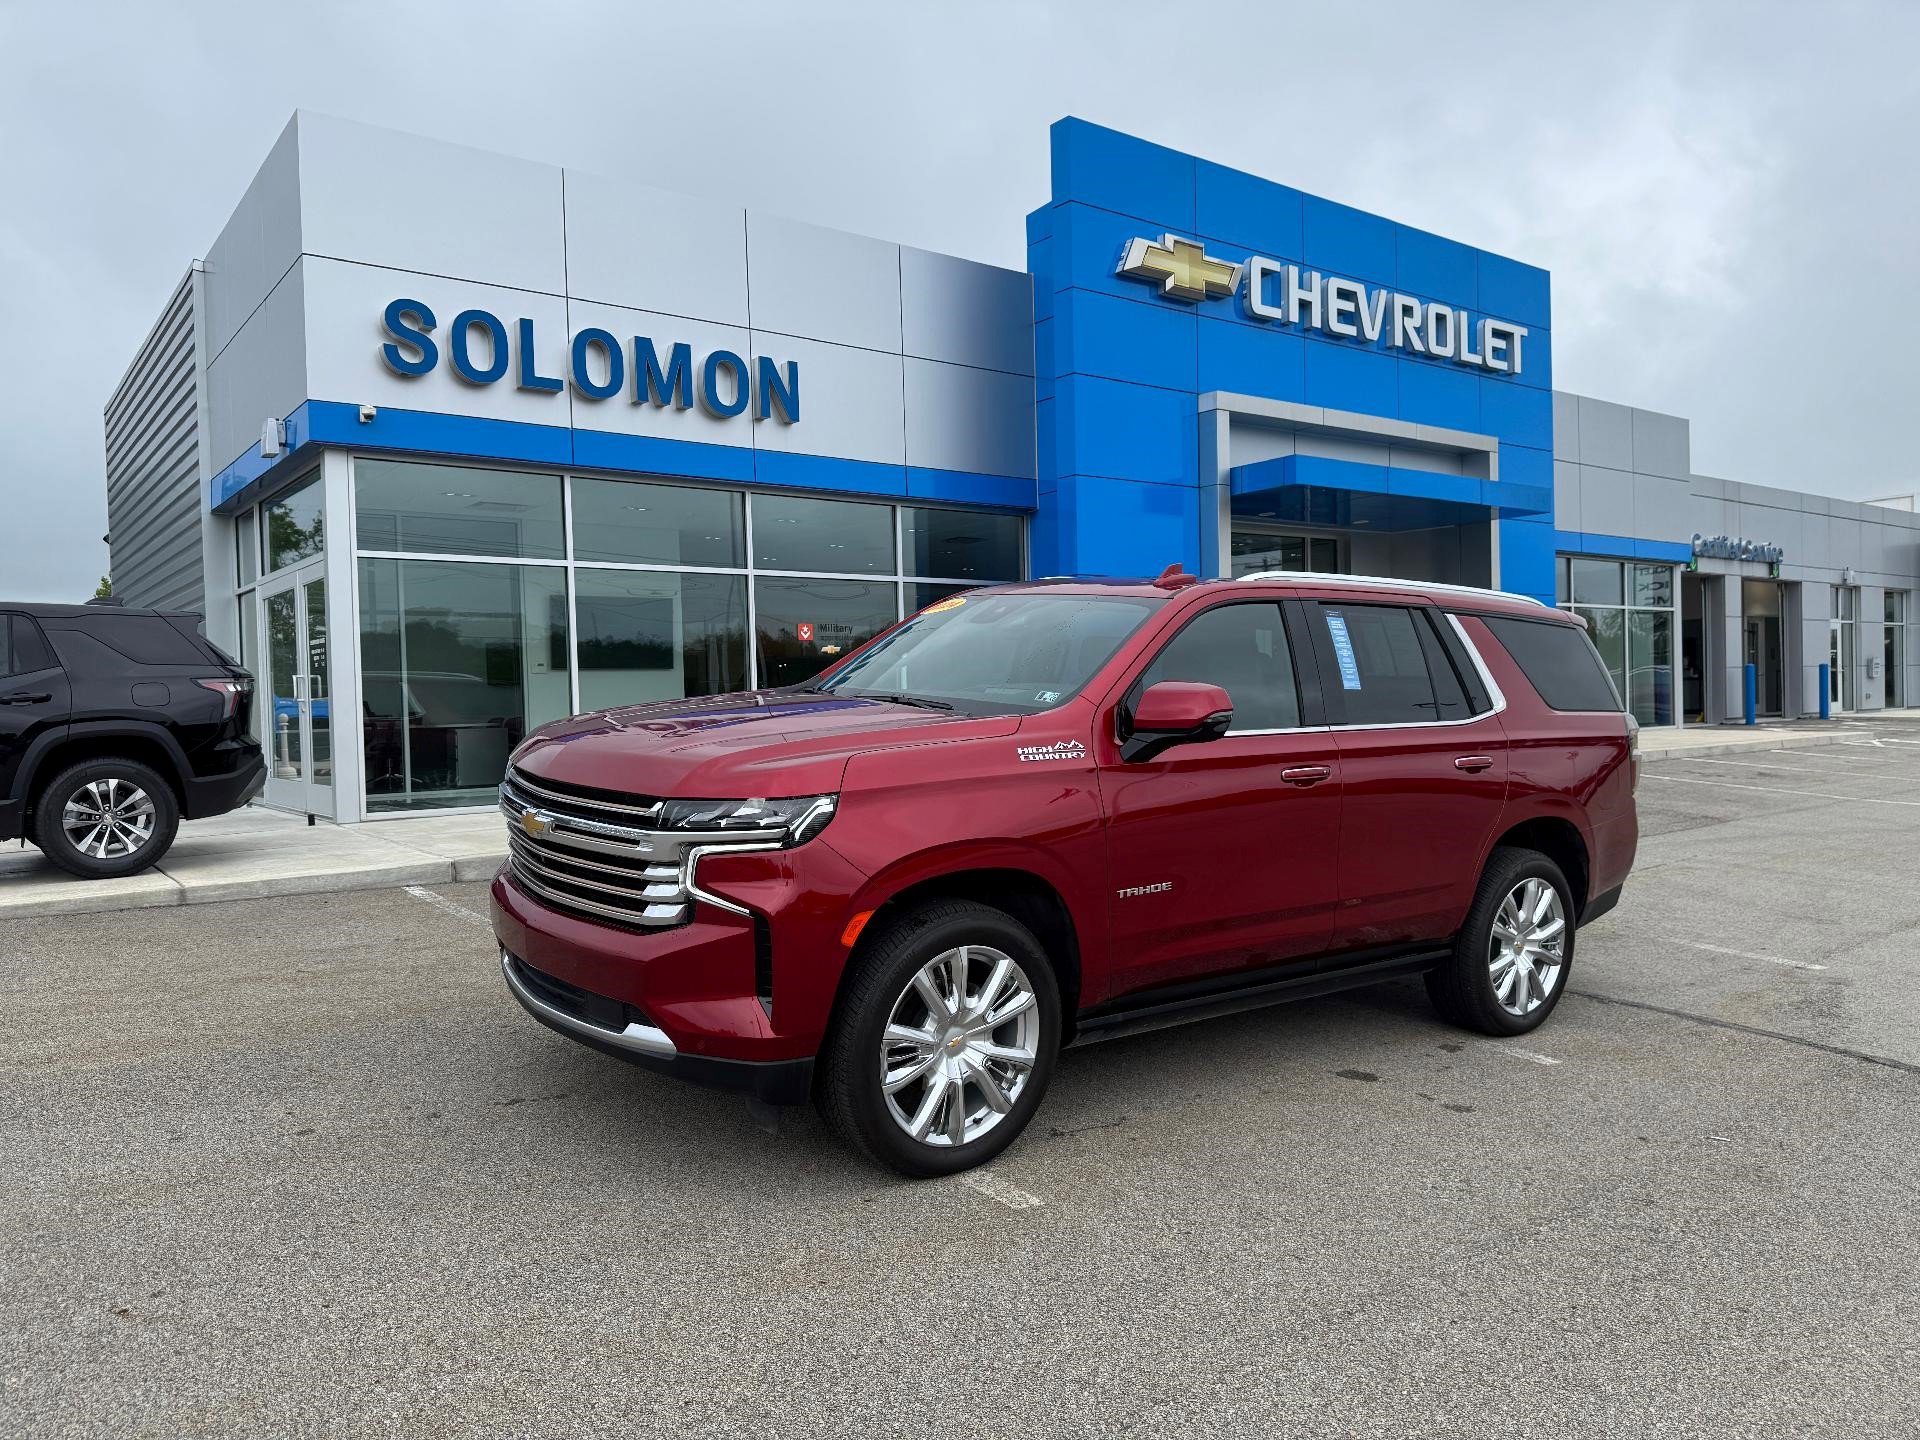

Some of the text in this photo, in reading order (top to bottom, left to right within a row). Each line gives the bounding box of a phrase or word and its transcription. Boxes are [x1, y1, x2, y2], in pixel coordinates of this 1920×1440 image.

[1243, 255, 1528, 374] CHEVROLET
[378, 298, 800, 424] SOLOMON
[819, 623, 853, 634] Military
[1017, 745, 1052, 755] HIGH
[1019, 751, 1086, 762] COUNTRY
[1116, 881, 1173, 899] TAHOE
